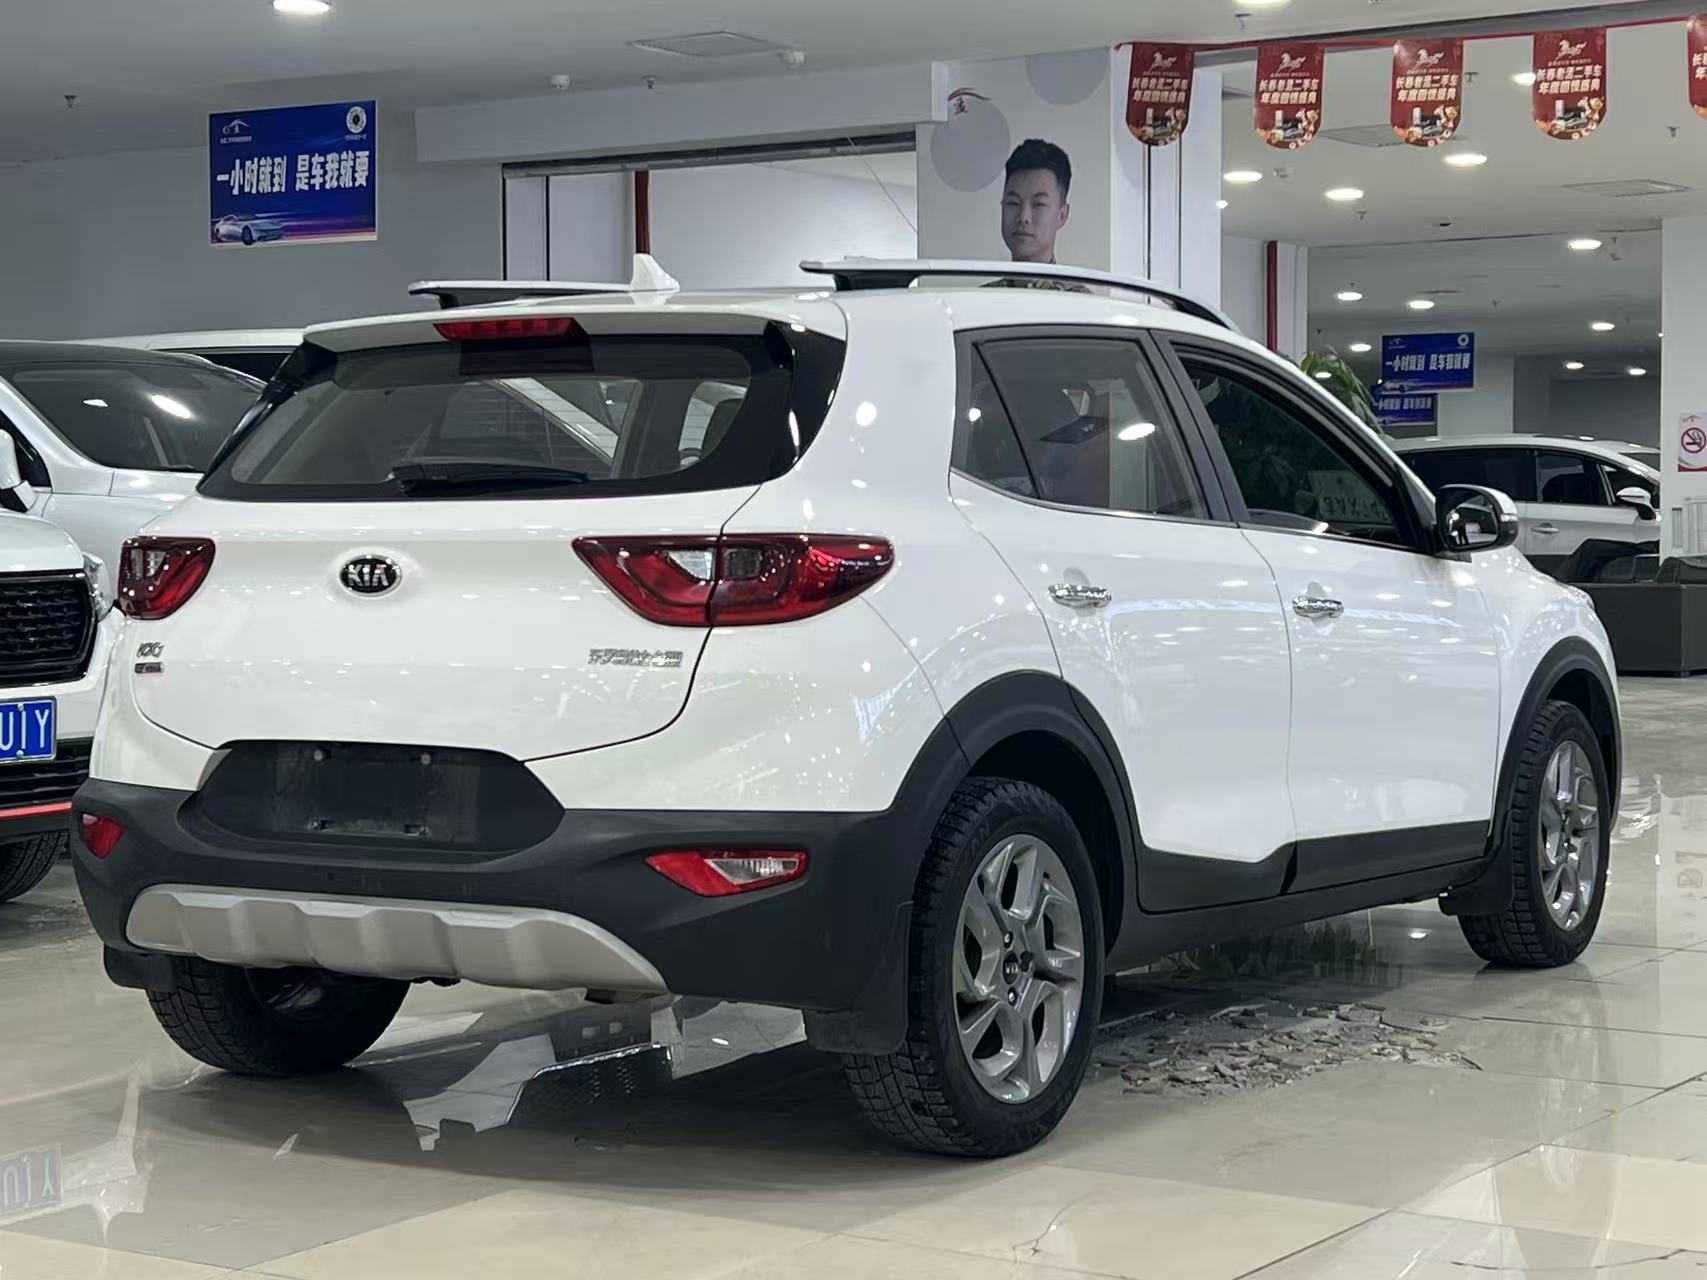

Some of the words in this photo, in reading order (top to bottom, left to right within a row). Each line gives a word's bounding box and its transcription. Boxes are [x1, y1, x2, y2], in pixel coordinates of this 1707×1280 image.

[216, 155, 287, 196] 一小时就到
[295, 150, 370, 192] 是车我就要
[347, 563, 390, 587] KIA
